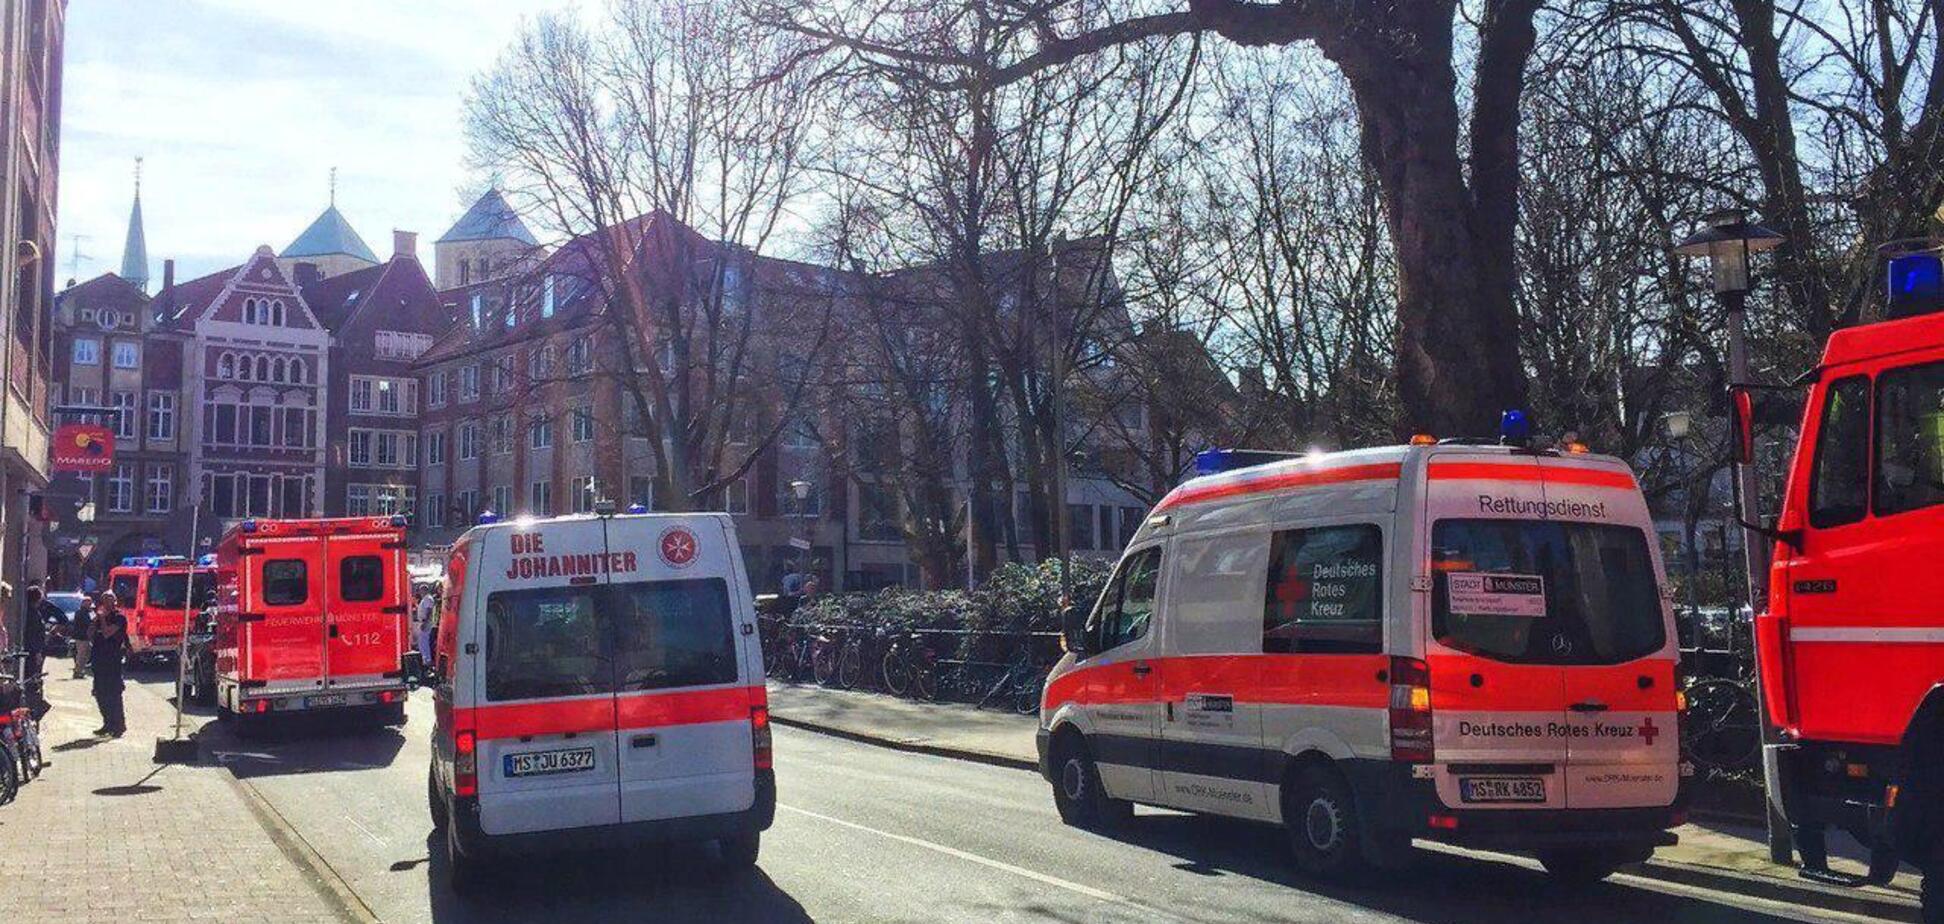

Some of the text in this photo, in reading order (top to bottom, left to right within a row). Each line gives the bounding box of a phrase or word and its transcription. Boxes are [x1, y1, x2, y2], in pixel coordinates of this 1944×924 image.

[1478, 495, 1606, 519] Rettungsdienst
[510, 532, 544, 555] DIE
[506, 551, 638, 579] JOHANNITER
[1312, 561, 1376, 579] Deutsches
[1311, 582, 1346, 598] Rotes
[1310, 601, 1345, 616] Kreuz
[353, 631, 380, 645] 112
[1459, 721, 1634, 738] Deutsches Rotes Kreuz
[561, 751, 592, 767] 6377
